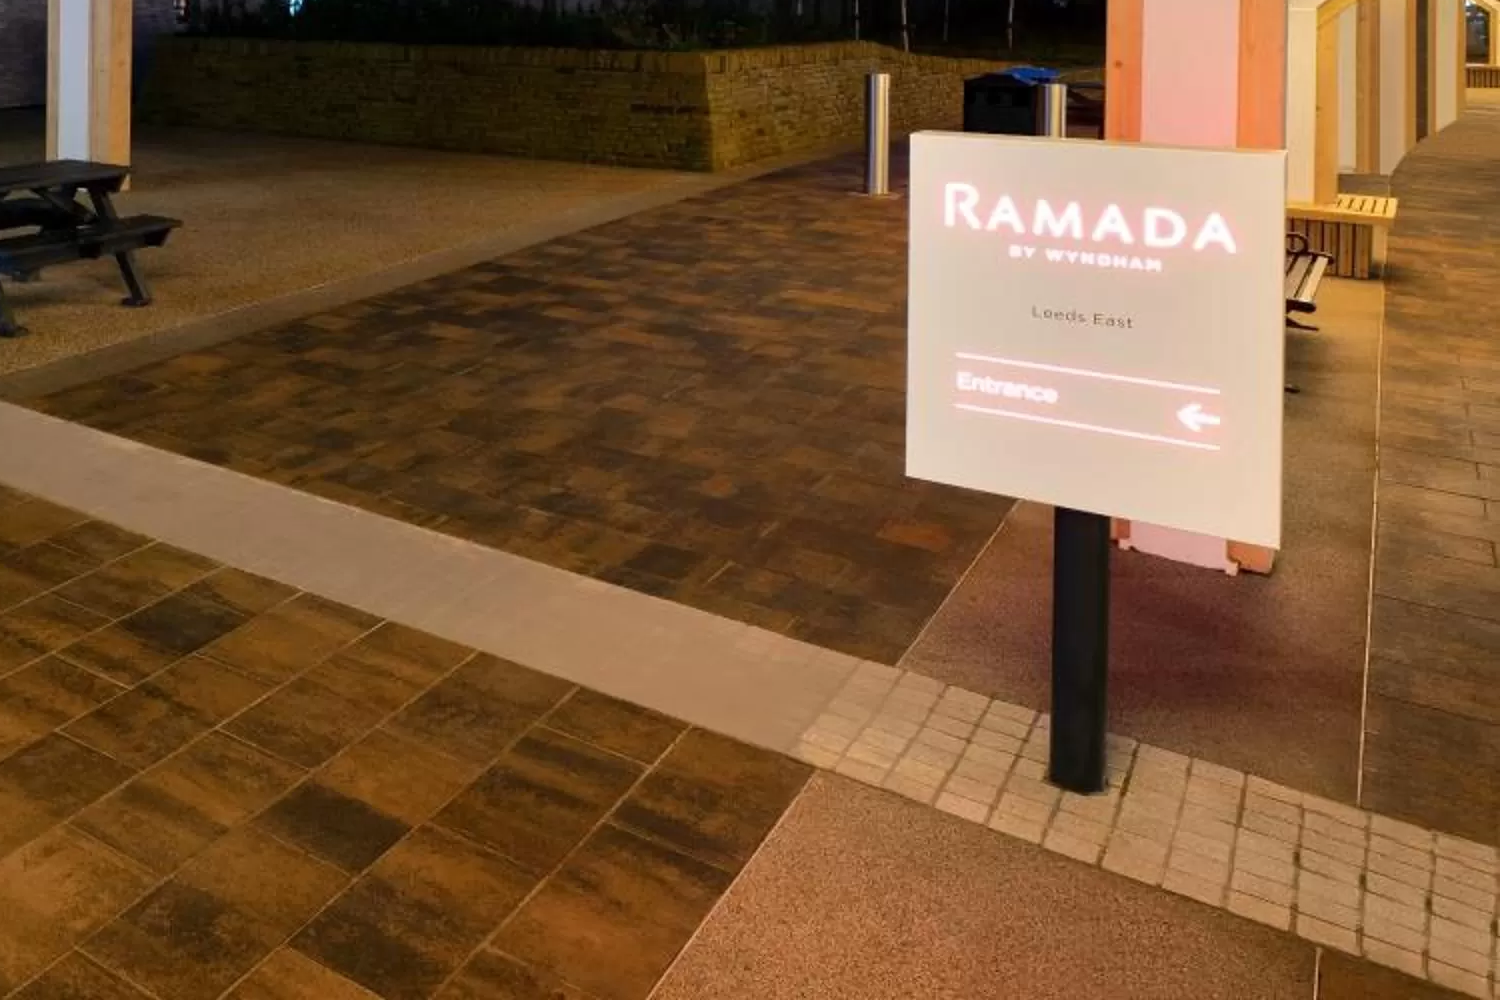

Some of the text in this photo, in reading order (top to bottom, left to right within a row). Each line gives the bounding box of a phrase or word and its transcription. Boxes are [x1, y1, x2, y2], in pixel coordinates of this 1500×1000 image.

[943, 181, 1237, 254] RAMADA
[1008, 244, 1163, 272] BY WYNDHAM
[1093, 312, 1135, 329] East
[956, 371, 1059, 404] Entrance
